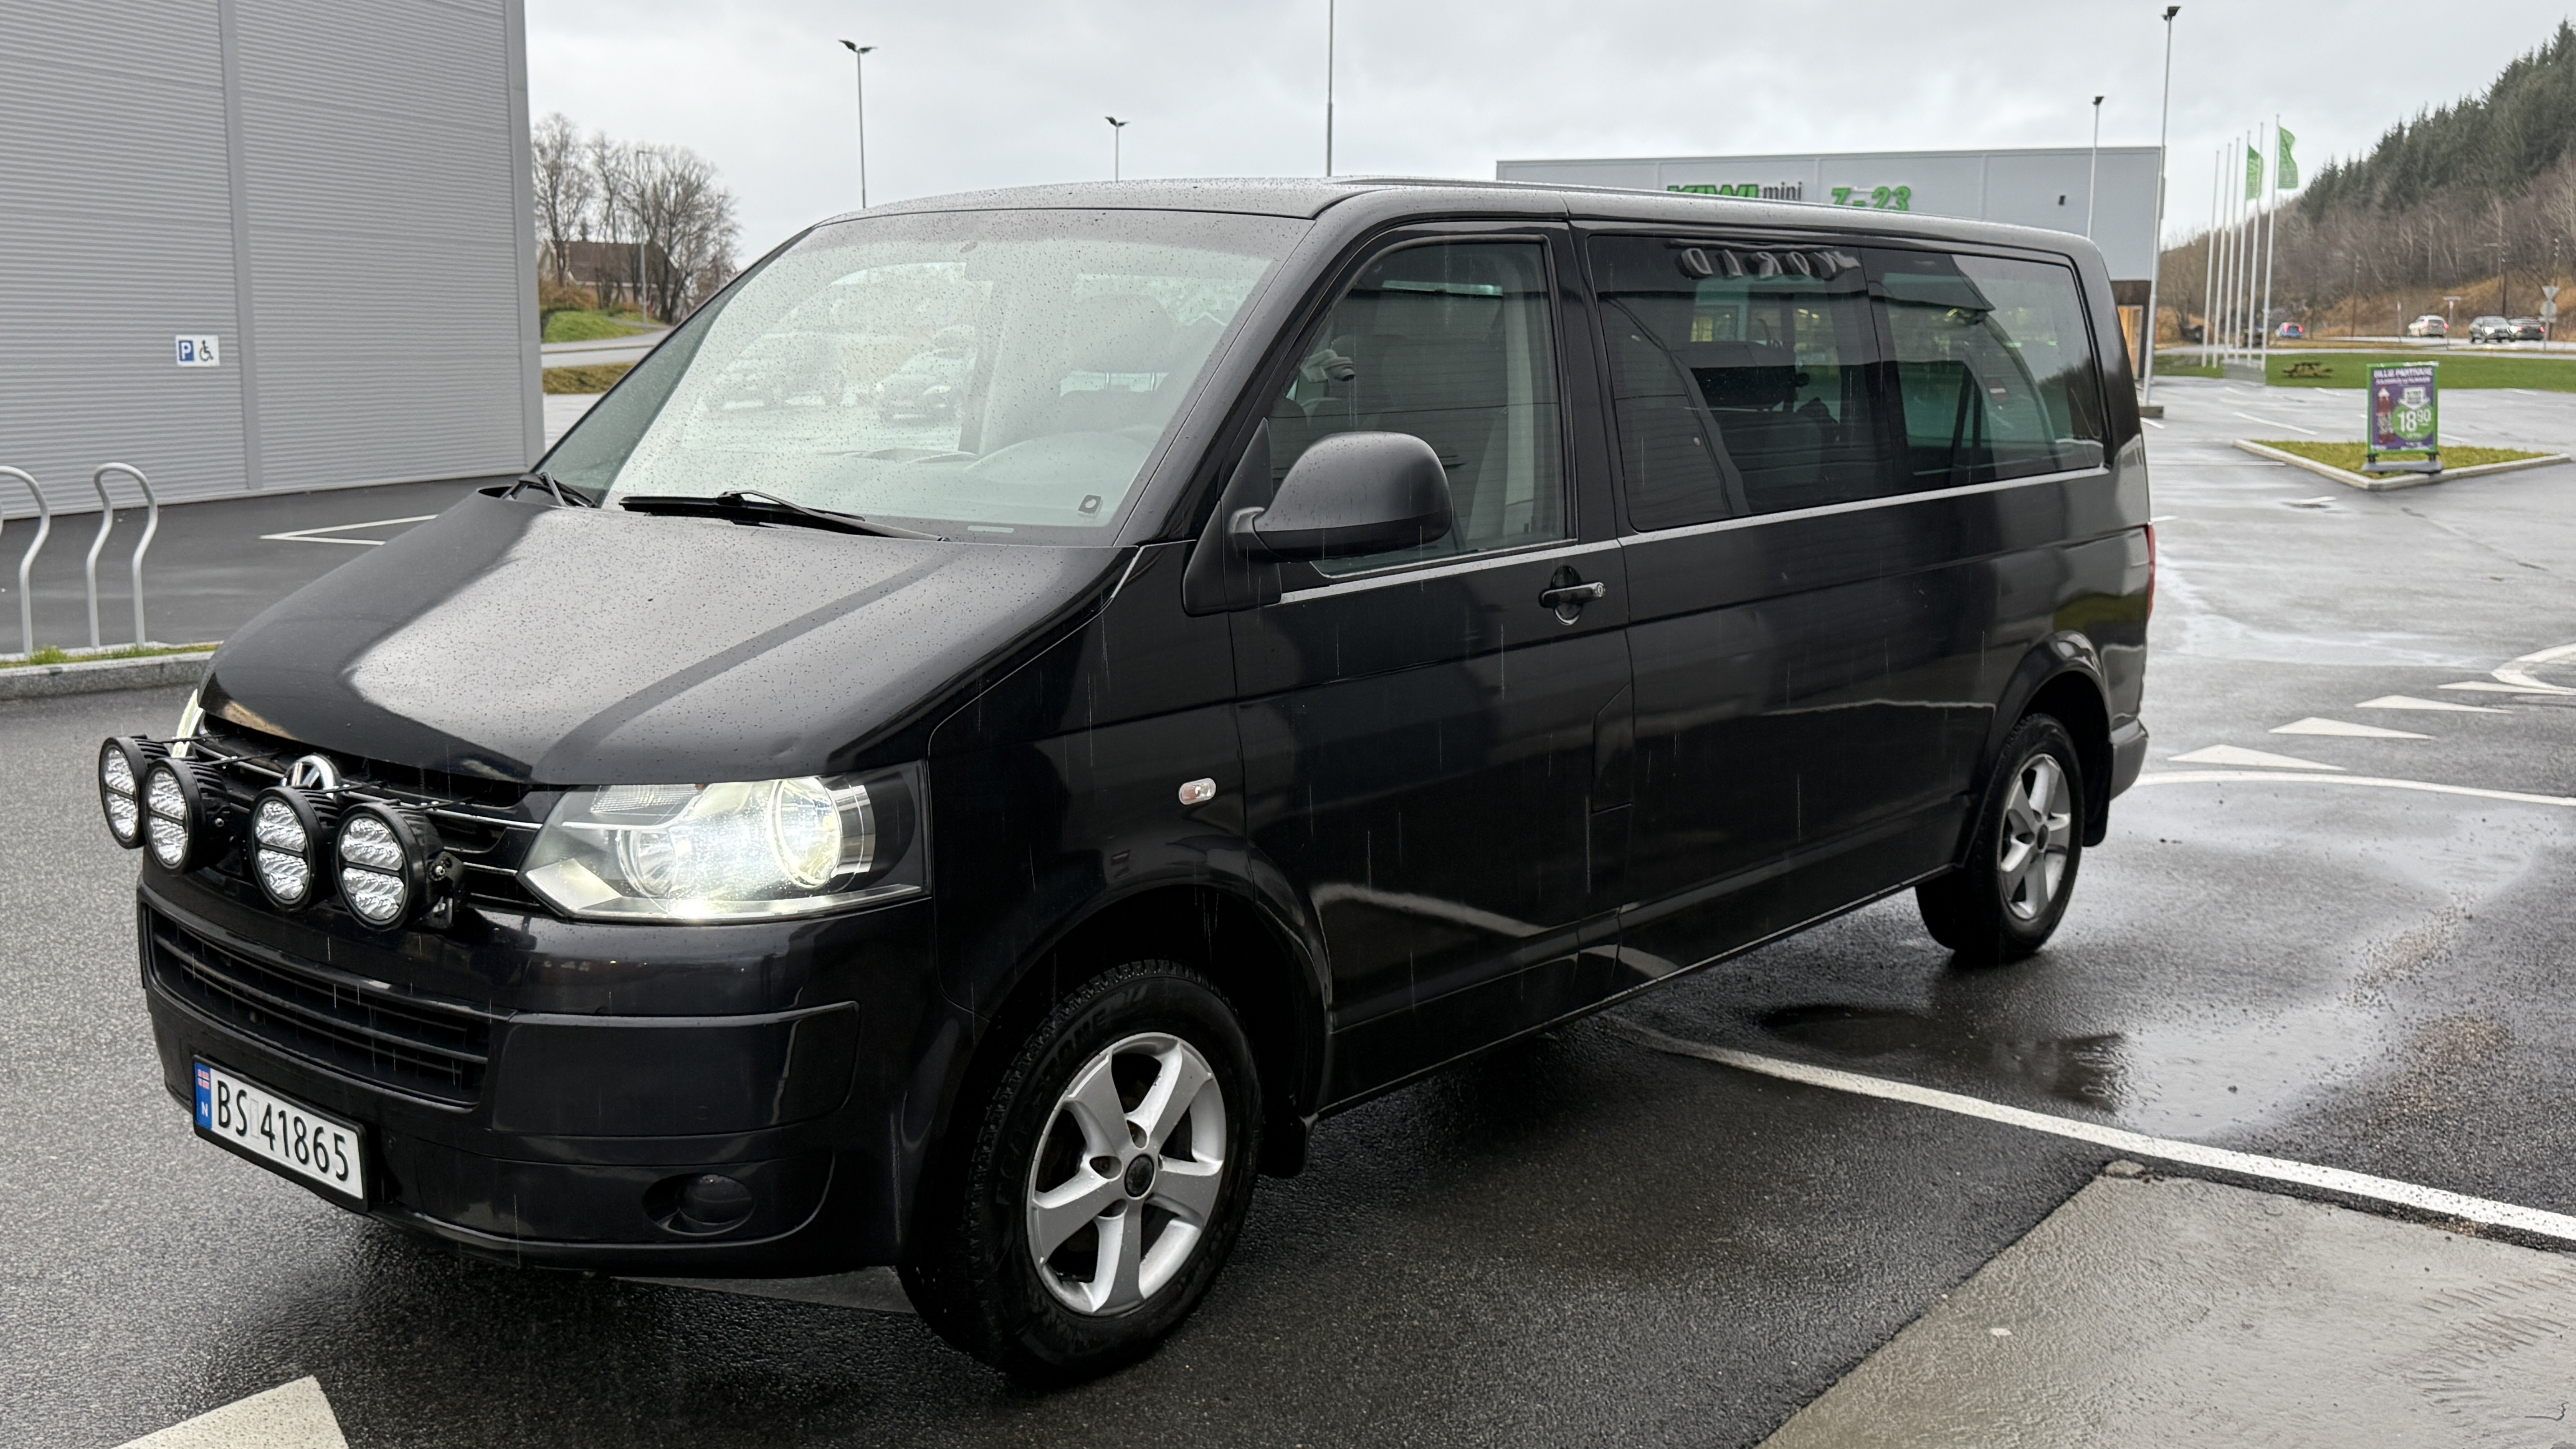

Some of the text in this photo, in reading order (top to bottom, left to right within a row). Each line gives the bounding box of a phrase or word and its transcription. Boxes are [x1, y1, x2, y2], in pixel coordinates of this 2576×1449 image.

[1763, 182, 1801, 200] mini
[1831, 186, 1911, 211] 7-23
[181, 342, 192, 360] P
[201, 1102, 209, 1118] N
[217, 1080, 349, 1182] BS 41865
